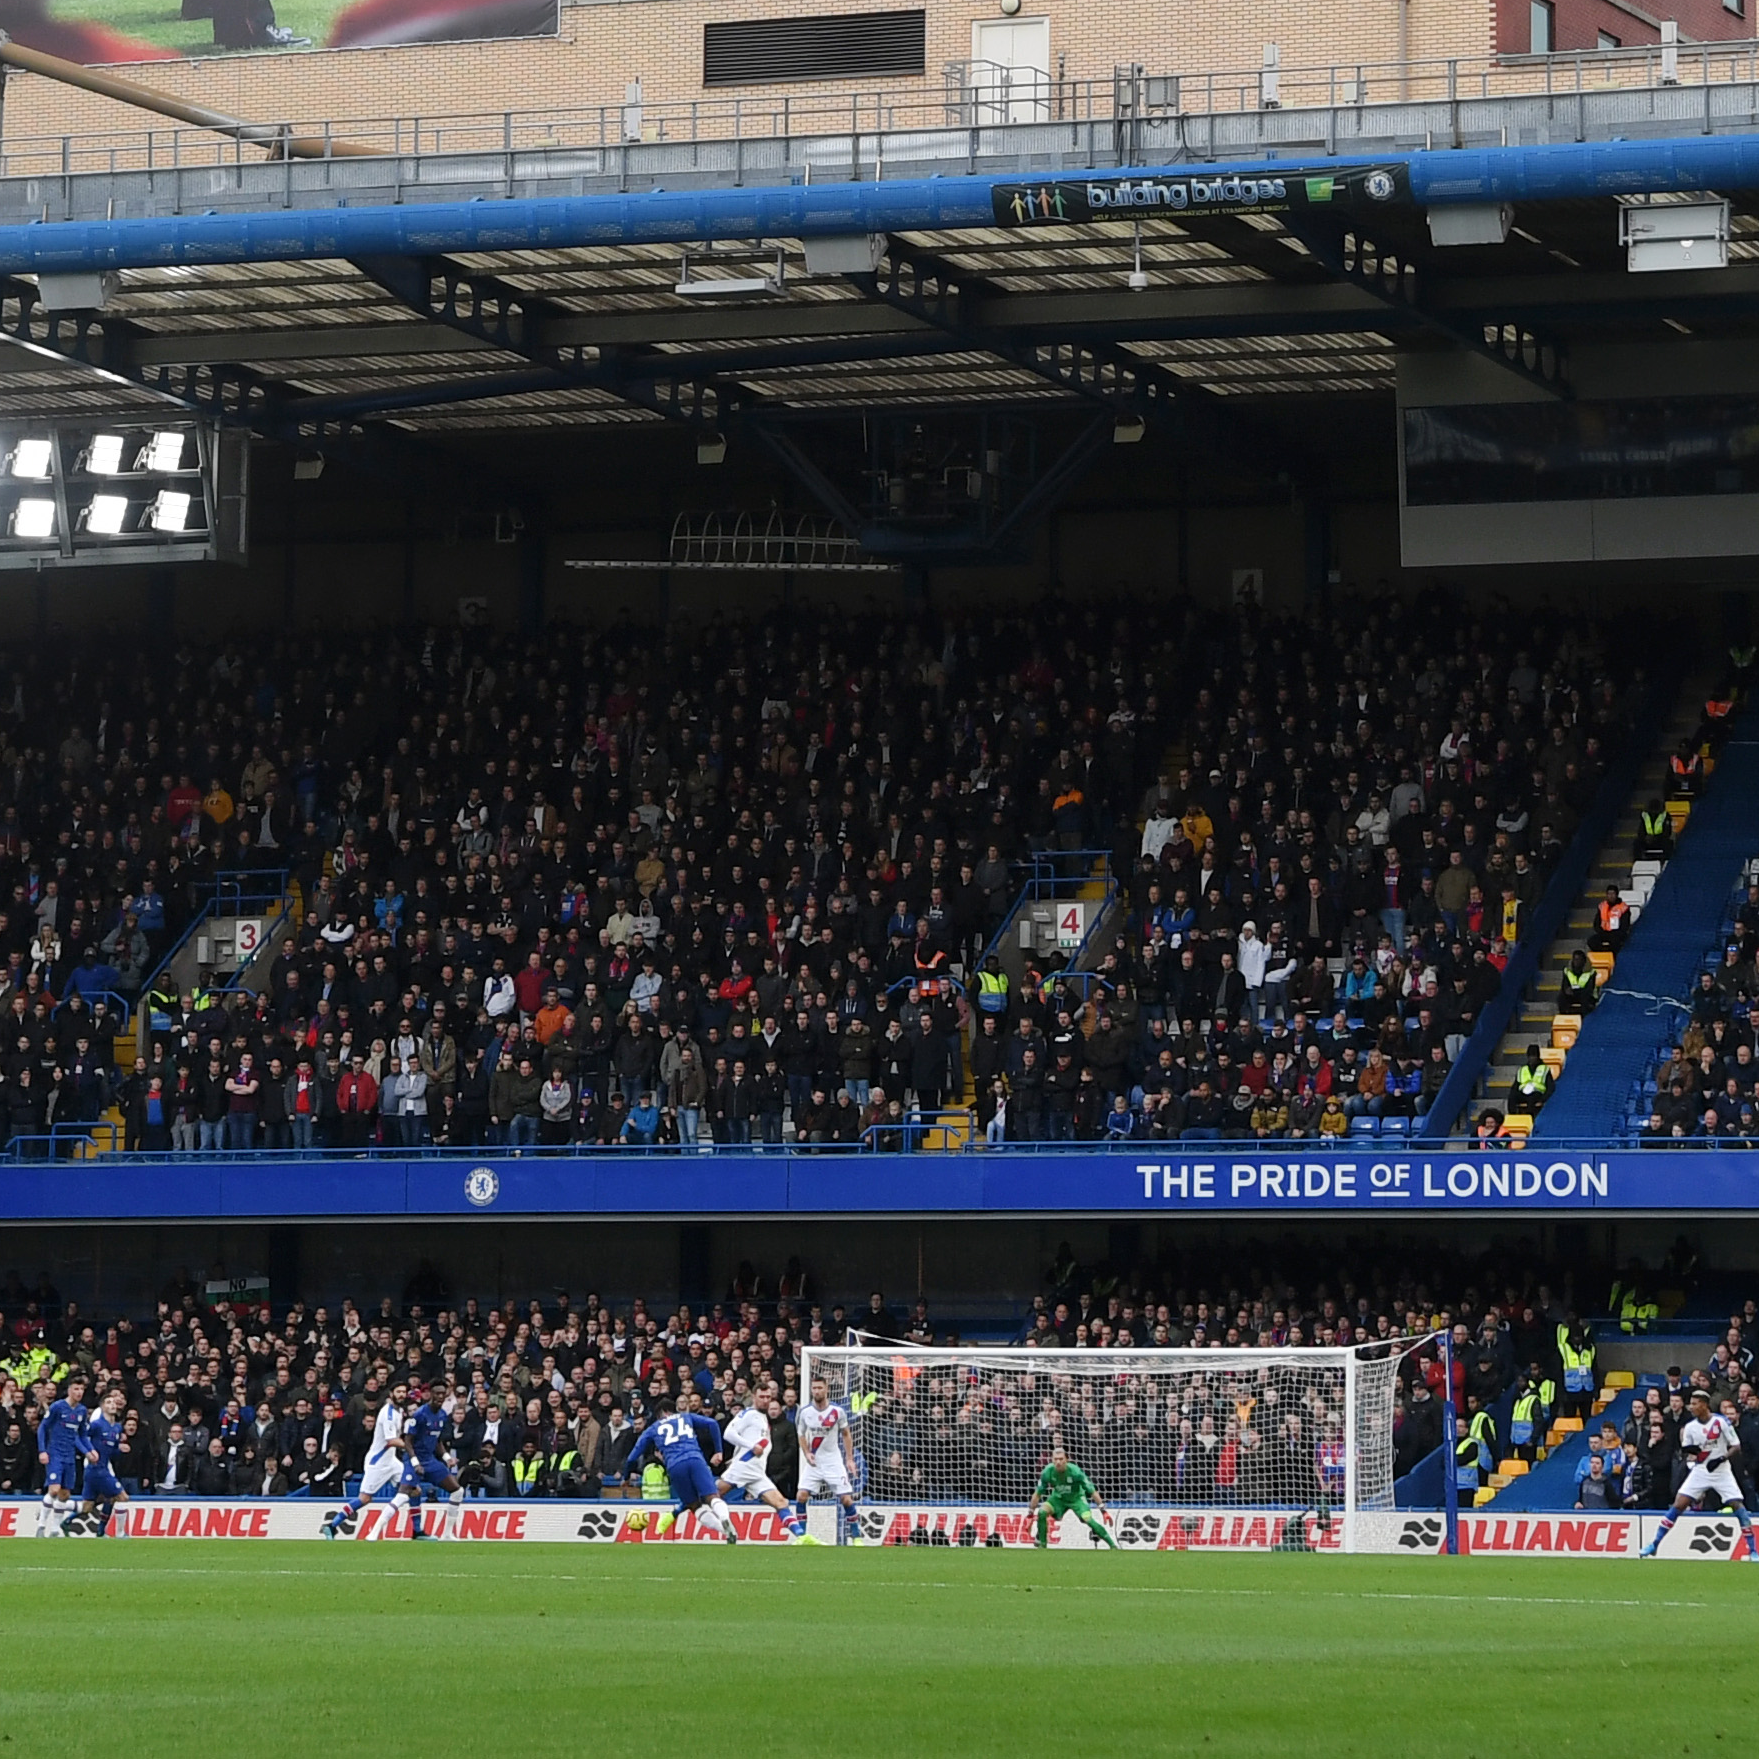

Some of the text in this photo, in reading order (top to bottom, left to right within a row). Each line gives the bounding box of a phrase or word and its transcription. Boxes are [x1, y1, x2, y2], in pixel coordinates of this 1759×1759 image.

[1087, 177, 1286, 209] building bridges
[1150, 209, 1211, 218] DISCRIMINATION
[1222, 206, 1262, 214] STAMFORD
[1236, 574, 1255, 603] 4
[1060, 908, 1080, 934] 4
[240, 924, 256, 949] 3
[1136, 1162, 1608, 1200] THE PRIDE OF LONDON
[229, 1278, 247, 1291] NO
[657, 1417, 694, 1446] 24
[1438, 1520, 1630, 1555] ALLIANCE
